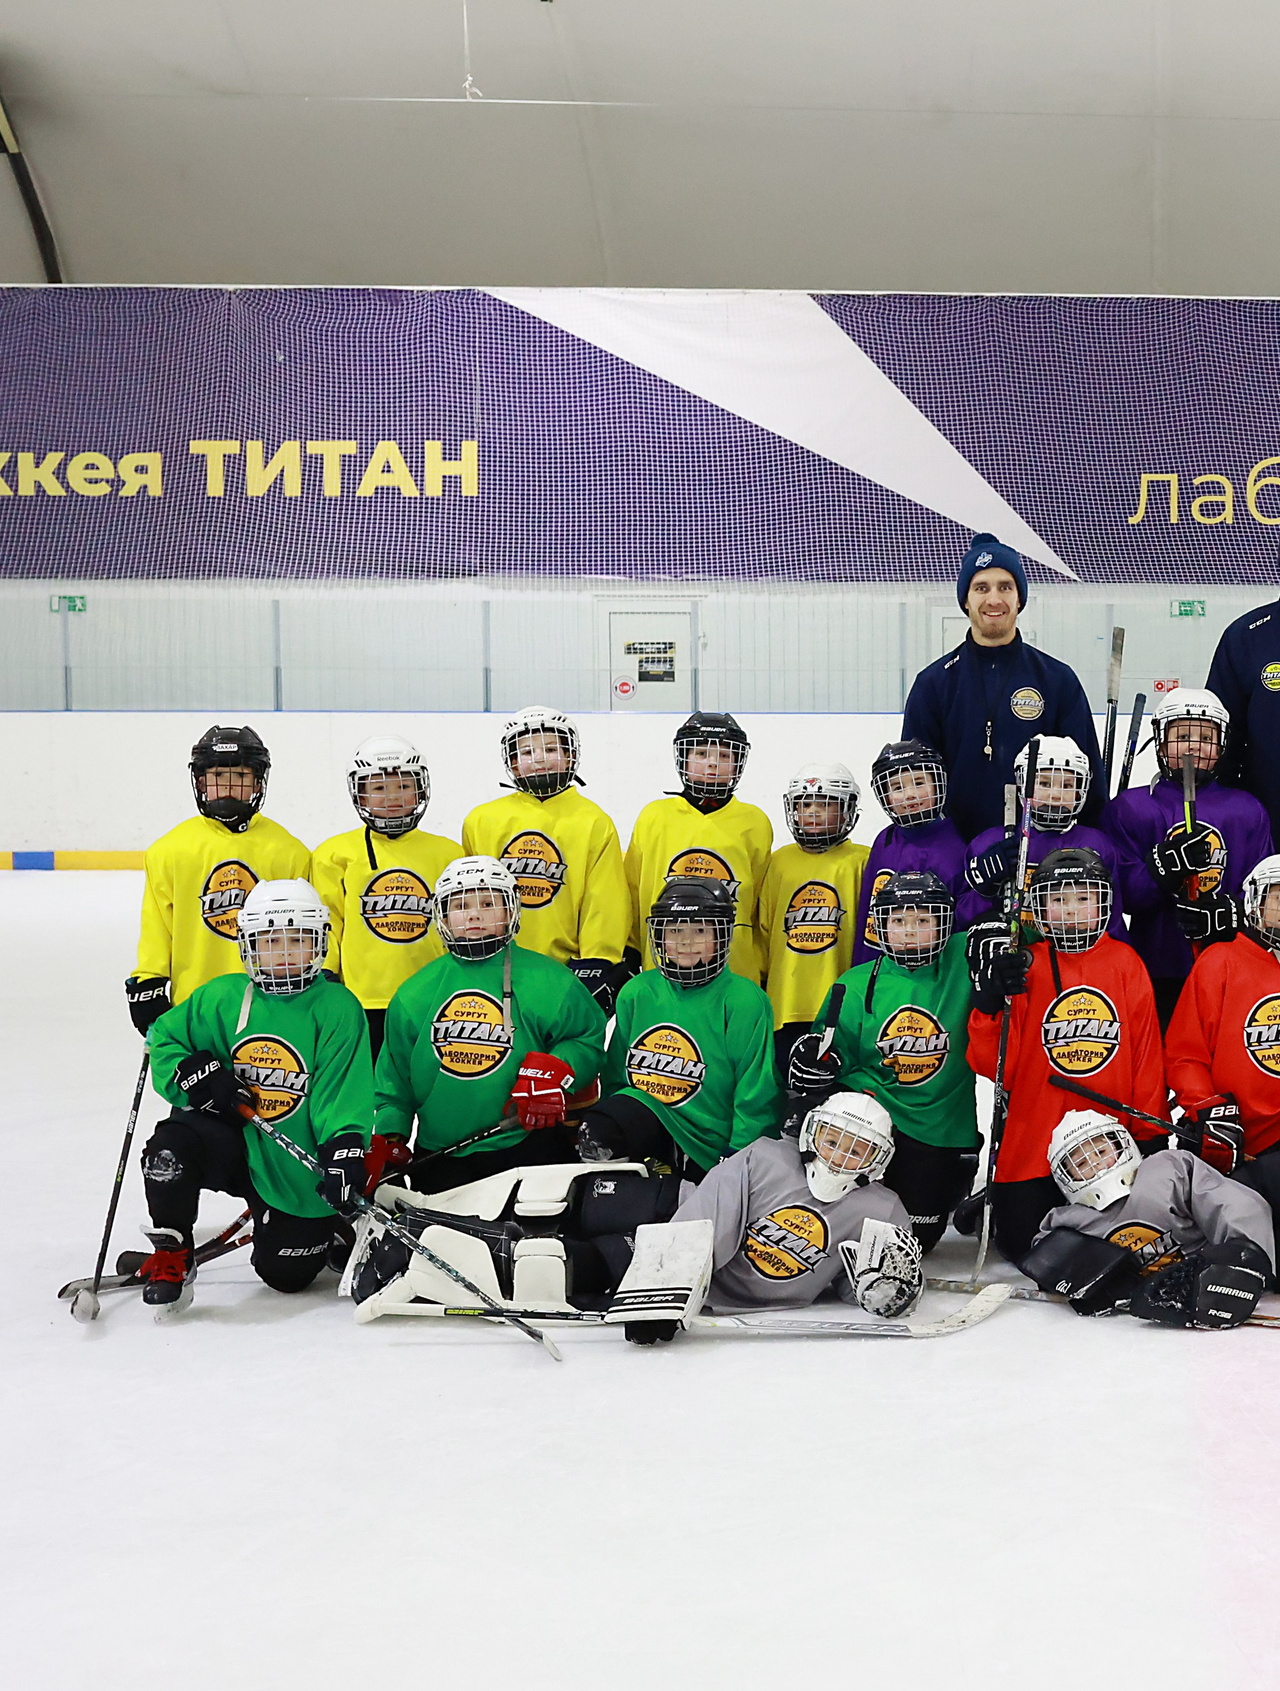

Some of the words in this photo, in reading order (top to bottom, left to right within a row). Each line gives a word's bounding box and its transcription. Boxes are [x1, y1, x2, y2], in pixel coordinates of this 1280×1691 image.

[190, 440, 478, 496] ТИТАН
[1249, 615, 1271, 630] CCM
[377, 755, 400, 763] Reebok
[456, 869, 485, 877] CCM
[500, 857, 567, 879] ТИТАН
[685, 867, 714, 875] СУРГУТ
[1054, 867, 1083, 875] BAUER
[384, 885, 414, 893] СУРГУТ
[361, 895, 433, 913] ТИТАН
[670, 903, 699, 911] BAUER
[265, 908, 296, 916] BAUER
[575, 968, 603, 978] UER
[127, 985, 164, 1003] UER
[453, 1010, 488, 1020] СУРГУТ
[1067, 1008, 1097, 1016] СУРГУТ
[431, 1020, 514, 1043] ТИТАН
[1042, 1018, 1121, 1040] ТИТАН
[653, 1042, 682, 1054] СУРГУТ
[449, 1057, 483, 1066] ХОККЕЯ
[629, 1048, 708, 1078] ТИТАН
[518, 1066, 554, 1079] WELL
[1062, 1120, 1092, 1141] BAUER
[750, 1217, 830, 1265] ТИТАН
[277, 1242, 329, 1257] BAUER
[1206, 1285, 1255, 1300] WARRIOR
[622, 1294, 675, 1304] BAUER
